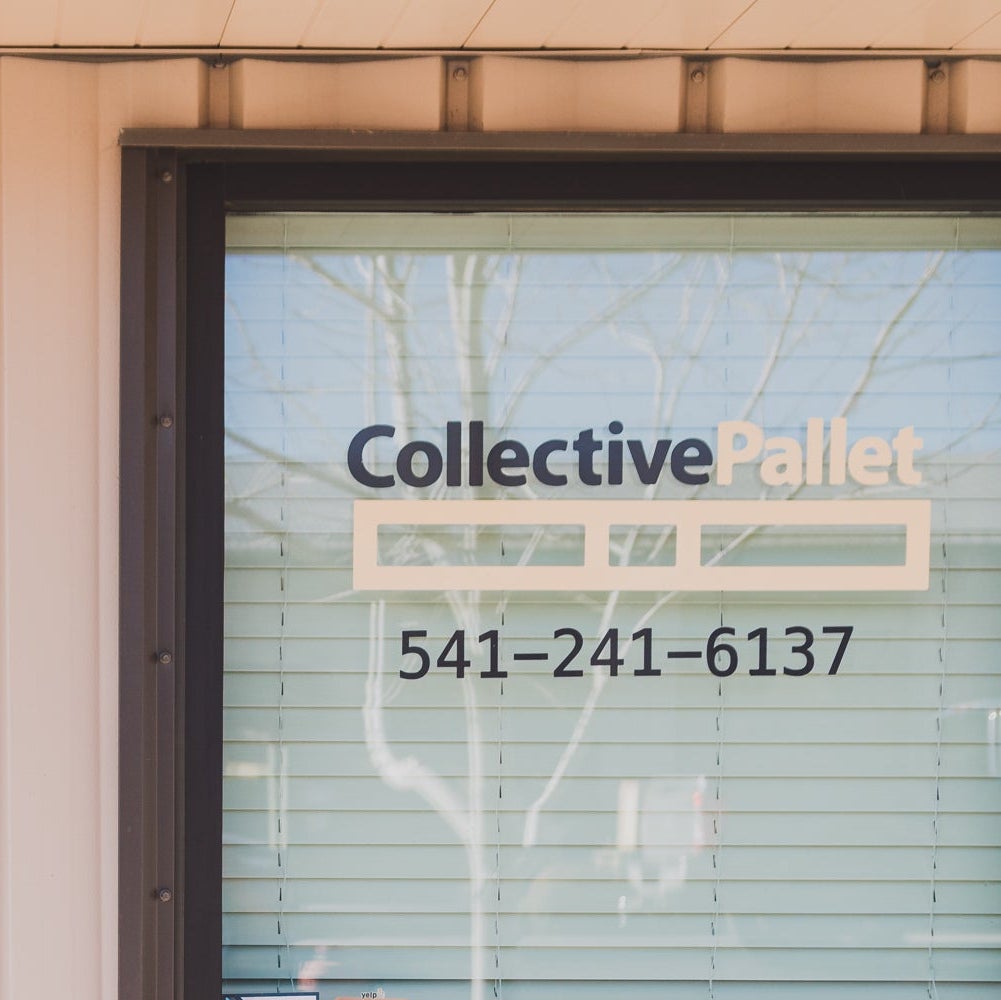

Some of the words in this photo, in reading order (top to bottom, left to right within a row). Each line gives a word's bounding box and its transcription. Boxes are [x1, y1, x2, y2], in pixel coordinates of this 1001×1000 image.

[347, 417, 924, 488] CollectivePallet
[399, 625, 855, 680] 541-241-6137
[361, 991, 377, 1000] yelp
